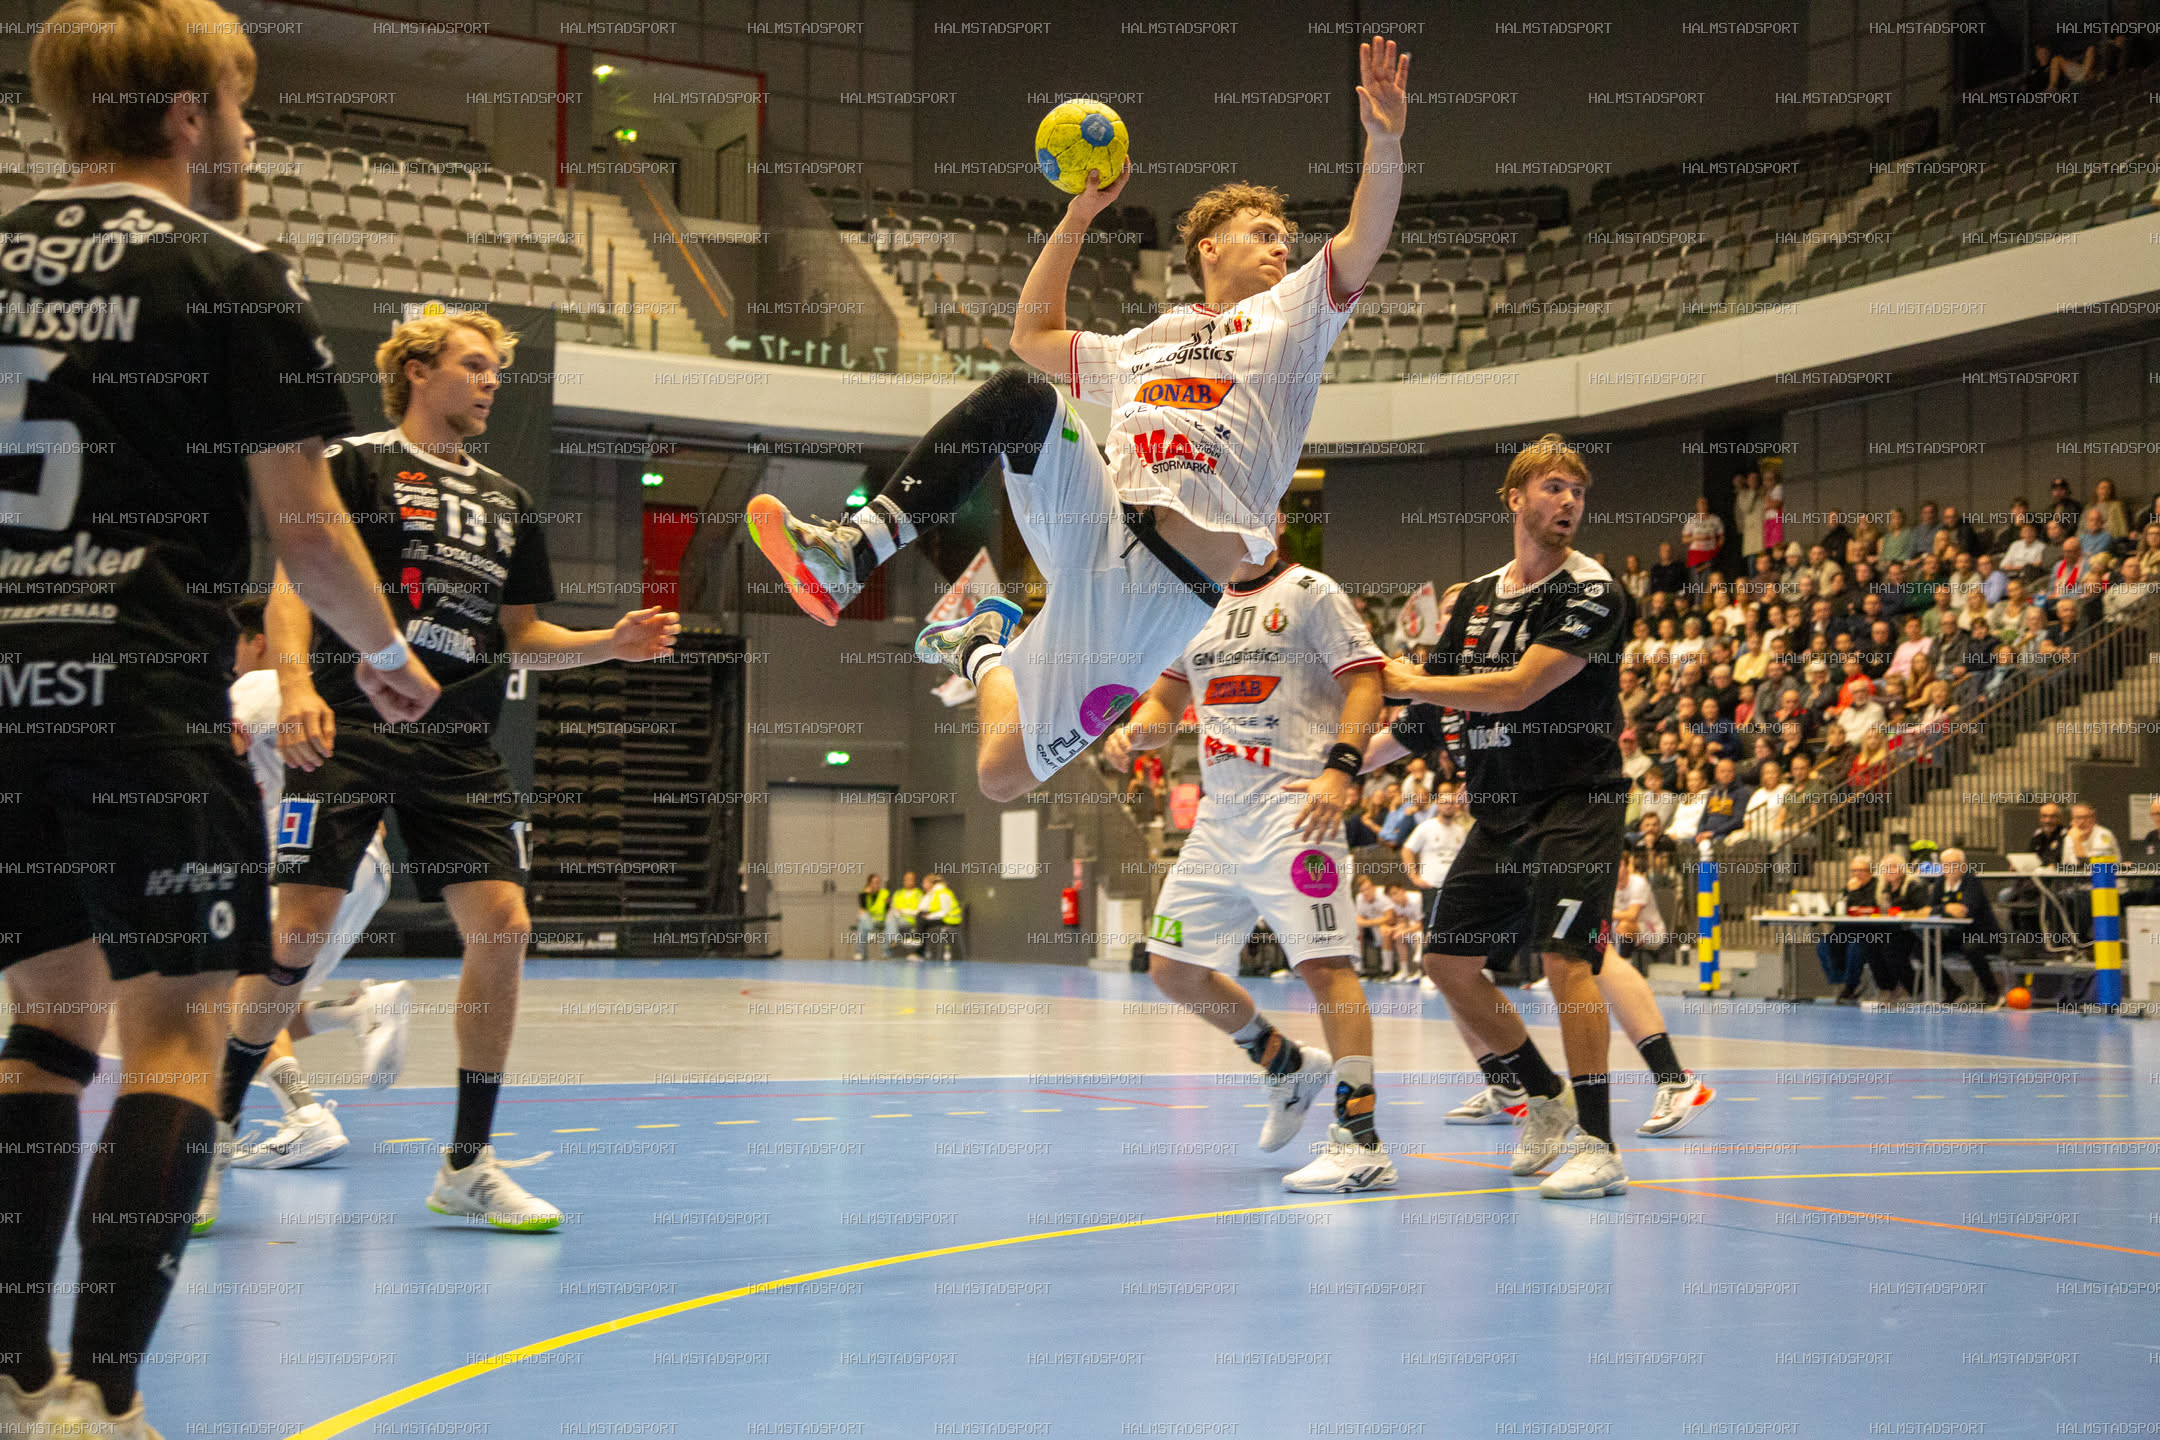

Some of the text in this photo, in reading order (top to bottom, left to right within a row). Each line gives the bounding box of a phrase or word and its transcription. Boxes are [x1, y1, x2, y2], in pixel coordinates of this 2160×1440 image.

[0, 289, 140, 342] NSSON
[441, 493, 488, 547] 13
[1223, 606, 1256, 640] 10
[0, 660, 119, 708] VEST
[1311, 903, 1338, 932] 10
[1552, 898, 1583, 940] 7
